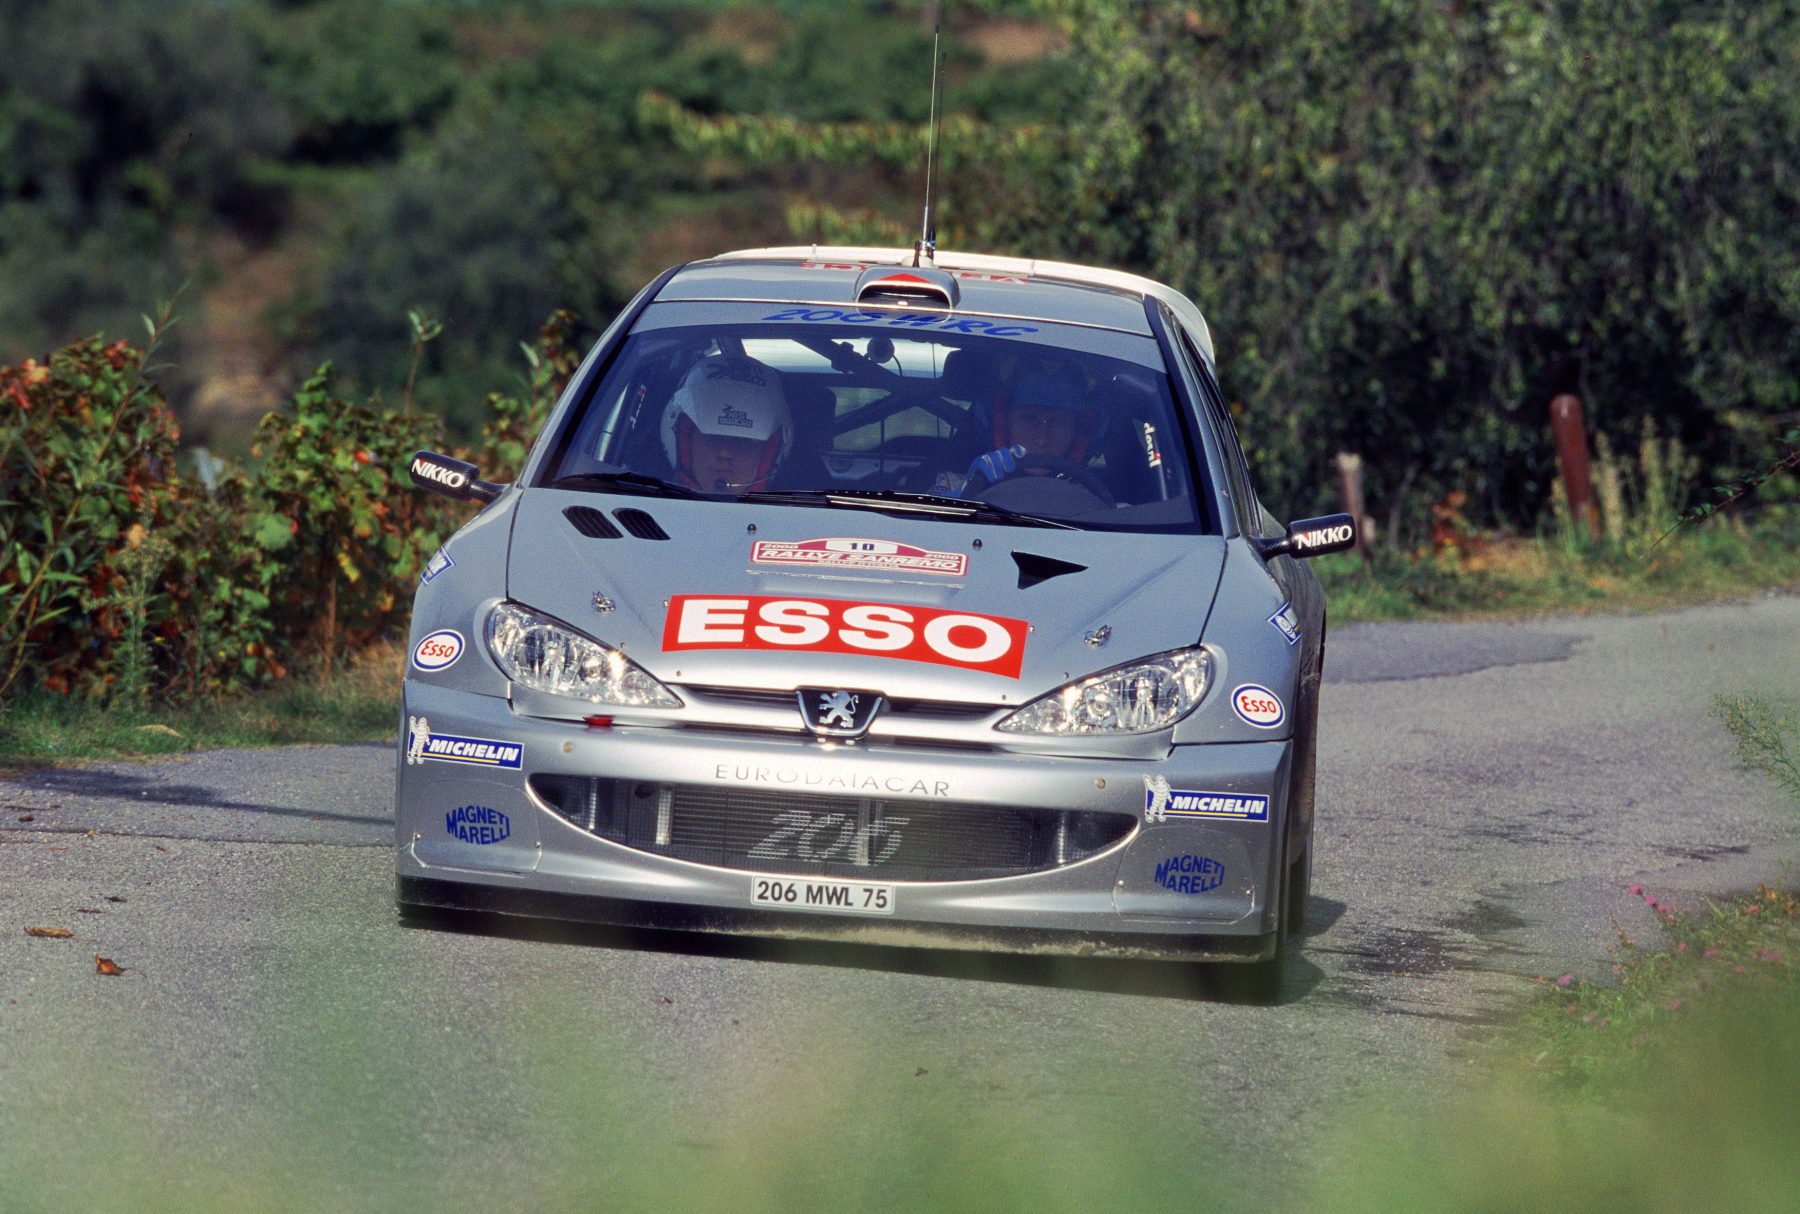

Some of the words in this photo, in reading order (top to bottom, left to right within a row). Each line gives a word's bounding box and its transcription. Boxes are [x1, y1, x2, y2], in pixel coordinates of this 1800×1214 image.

[411, 459, 465, 488] NIKKO
[850, 542, 874, 551] 10
[1297, 525, 1353, 549] NIKKO
[759, 550, 843, 562] RALLYE
[845, 554, 958, 569] SANREMO
[677, 599, 1012, 662] ESSO
[429, 739, 519, 762] MICHELIN
[446, 805, 510, 829] MAGNETI
[1172, 796, 1266, 815] MICHELIN
[446, 823, 510, 845] MARELLI
[747, 810, 911, 867] 206
[1154, 855, 1225, 878] MAGNETI
[757, 881, 797, 903] 206
[805, 885, 853, 907] MWL
[863, 888, 888, 908] 75
[1154, 872, 1225, 894] MARELLI
